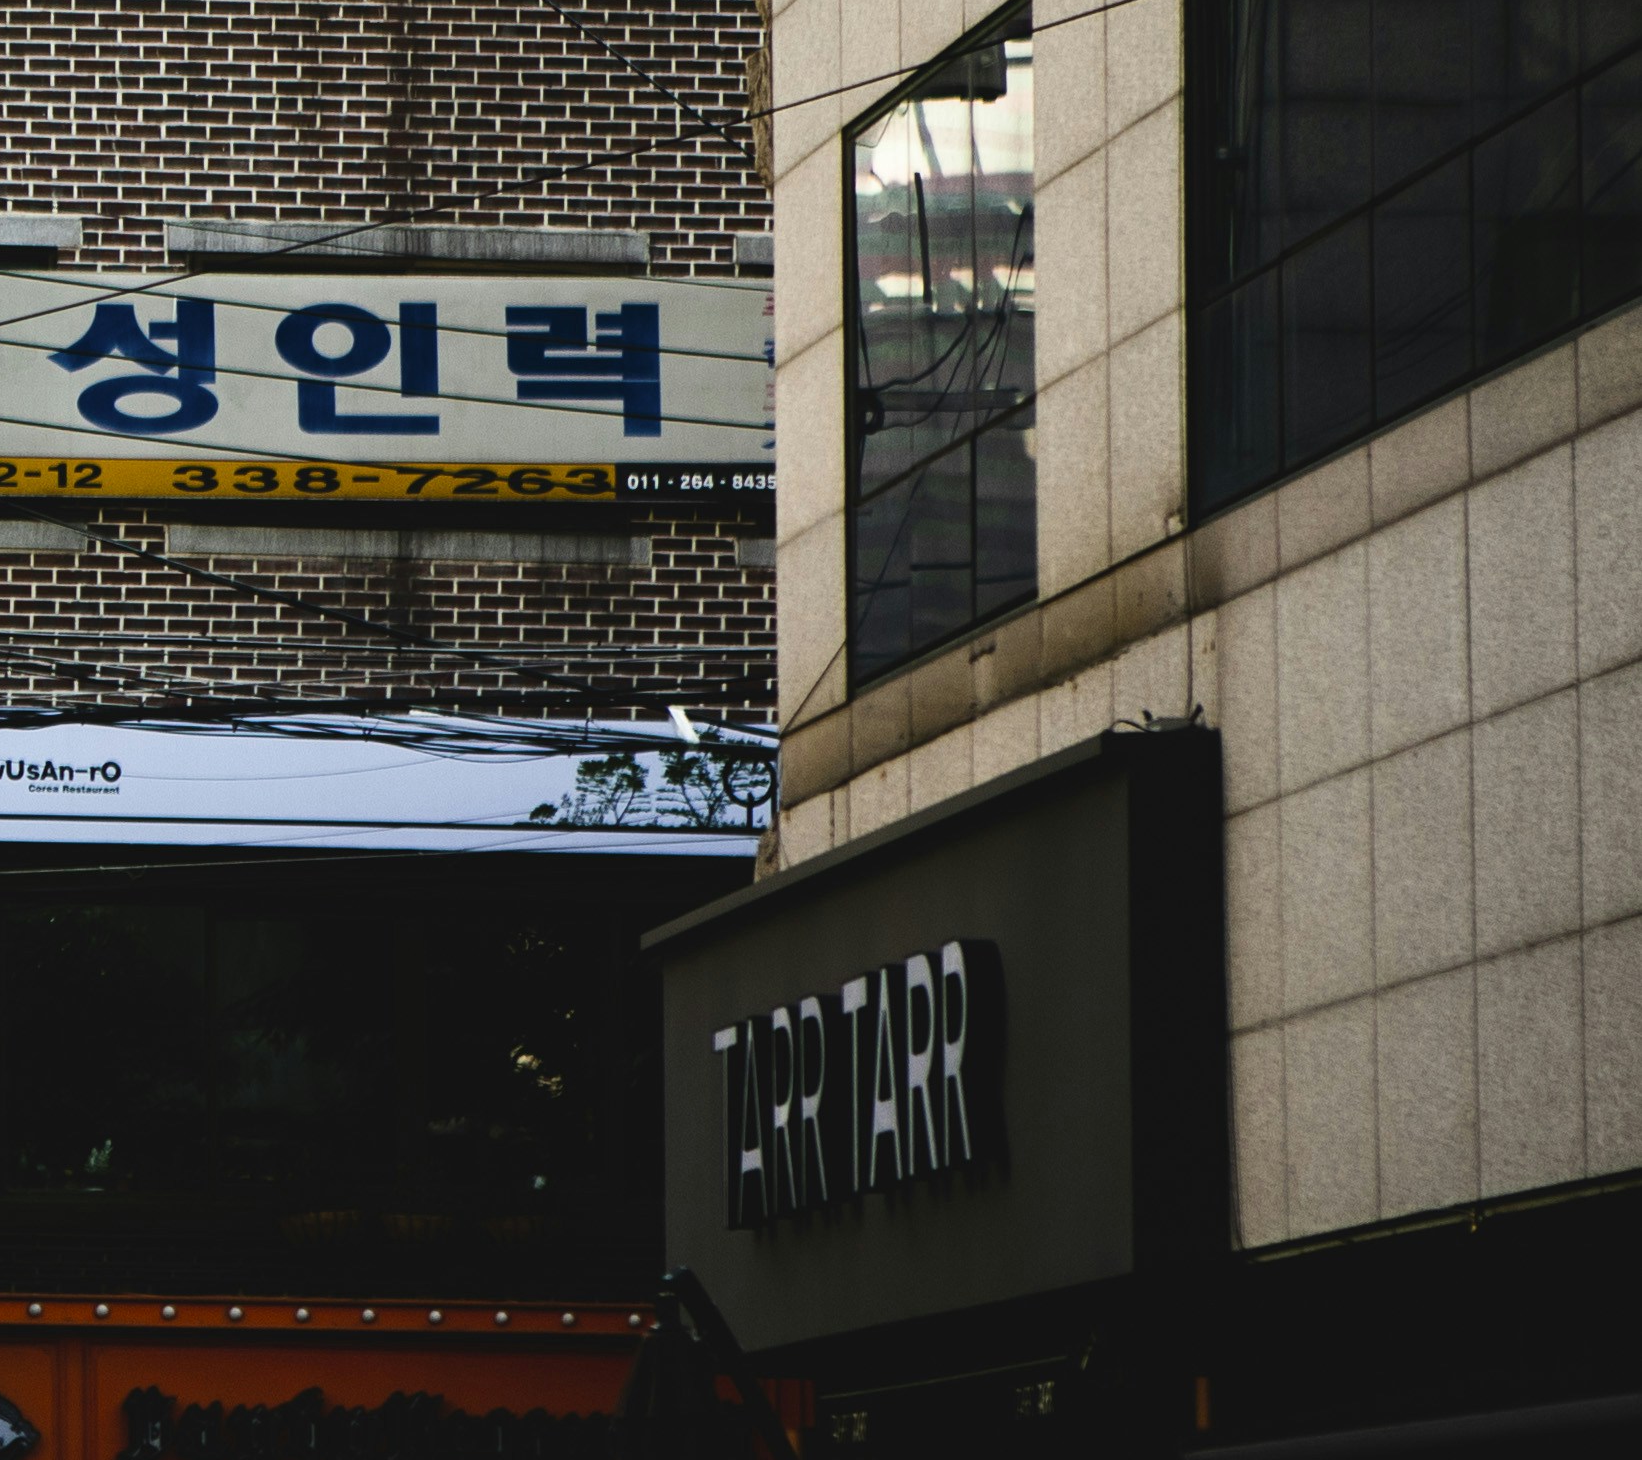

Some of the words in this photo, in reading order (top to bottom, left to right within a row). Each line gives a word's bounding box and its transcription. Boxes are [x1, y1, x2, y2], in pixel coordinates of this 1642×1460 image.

[172, 464, 615, 497] 338-7263
[714, 995, 827, 1230] TARR
[841, 939, 972, 1192] TARR
